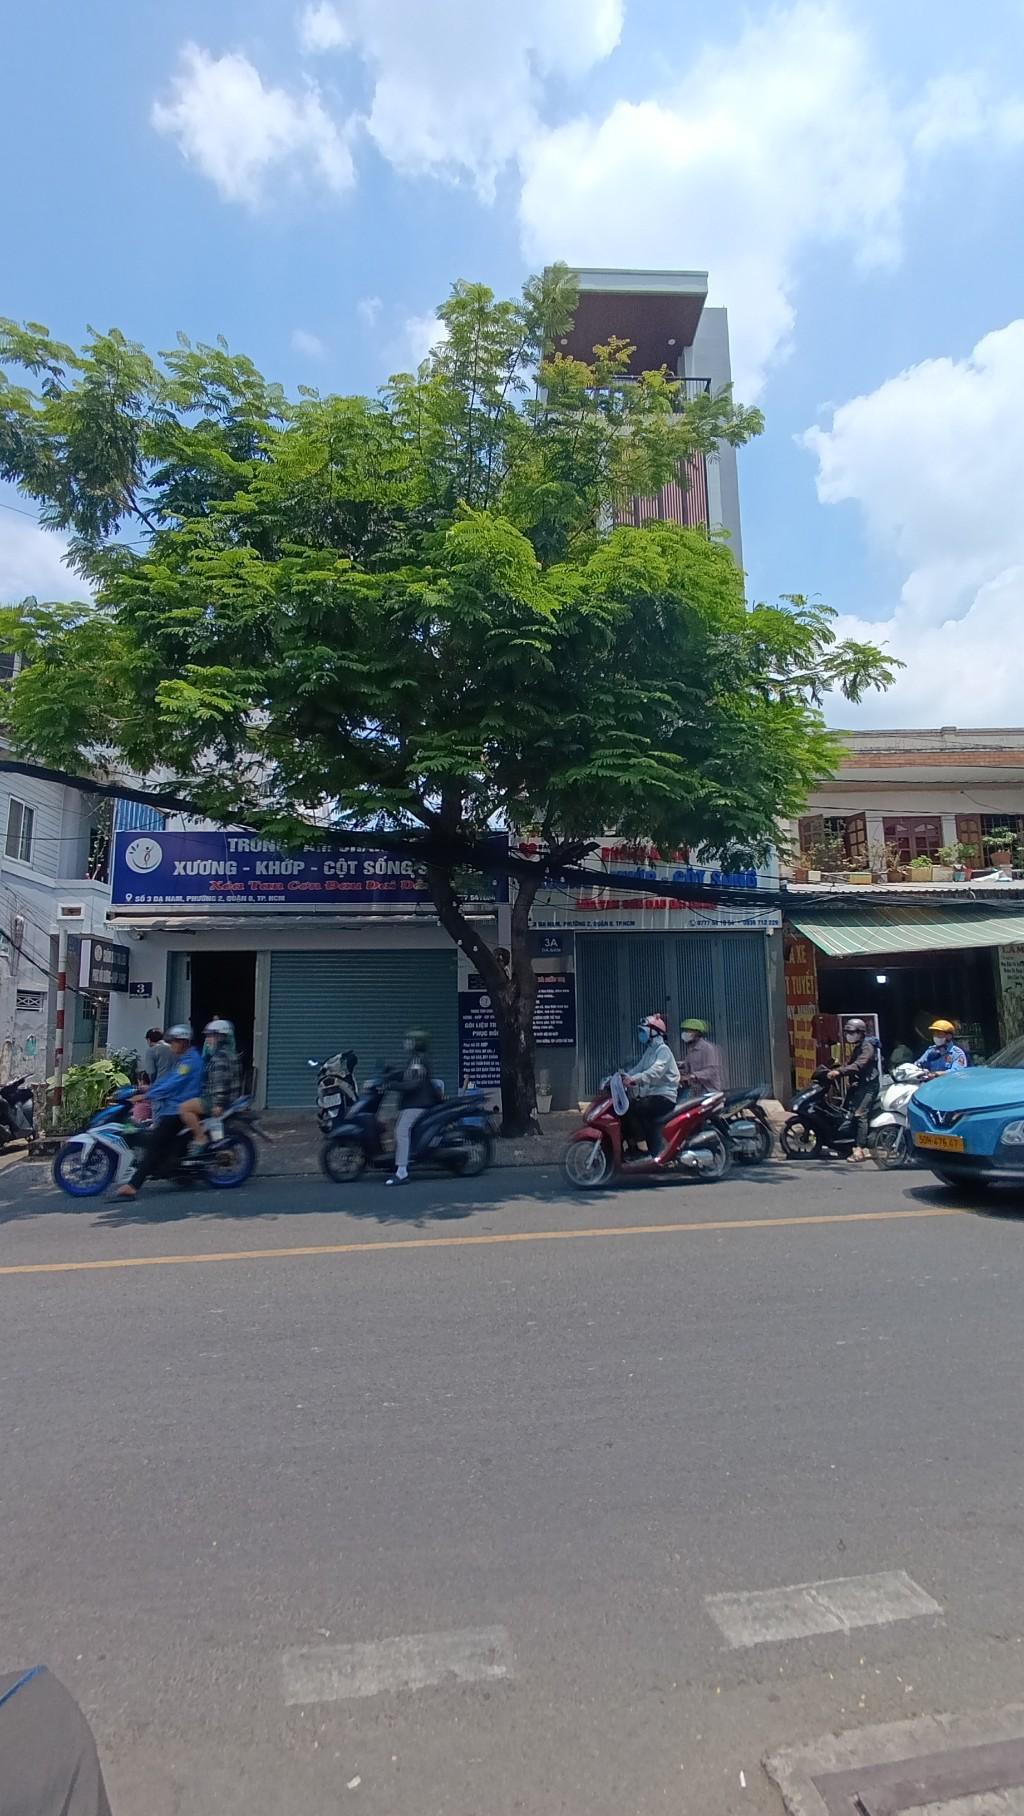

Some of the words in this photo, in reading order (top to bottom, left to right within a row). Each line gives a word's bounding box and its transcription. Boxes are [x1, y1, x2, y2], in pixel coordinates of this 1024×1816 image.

[173, 859, 238, 875] XƯƠNG
[255, 858, 305, 875] KHỚP
[323, 857, 358, 878] CỘT
[363, 855, 413, 876] SỐNG
[248, 880, 285, 891] Tan
[543, 938, 559, 947] 3A
[136, 983, 145, 994] 3
